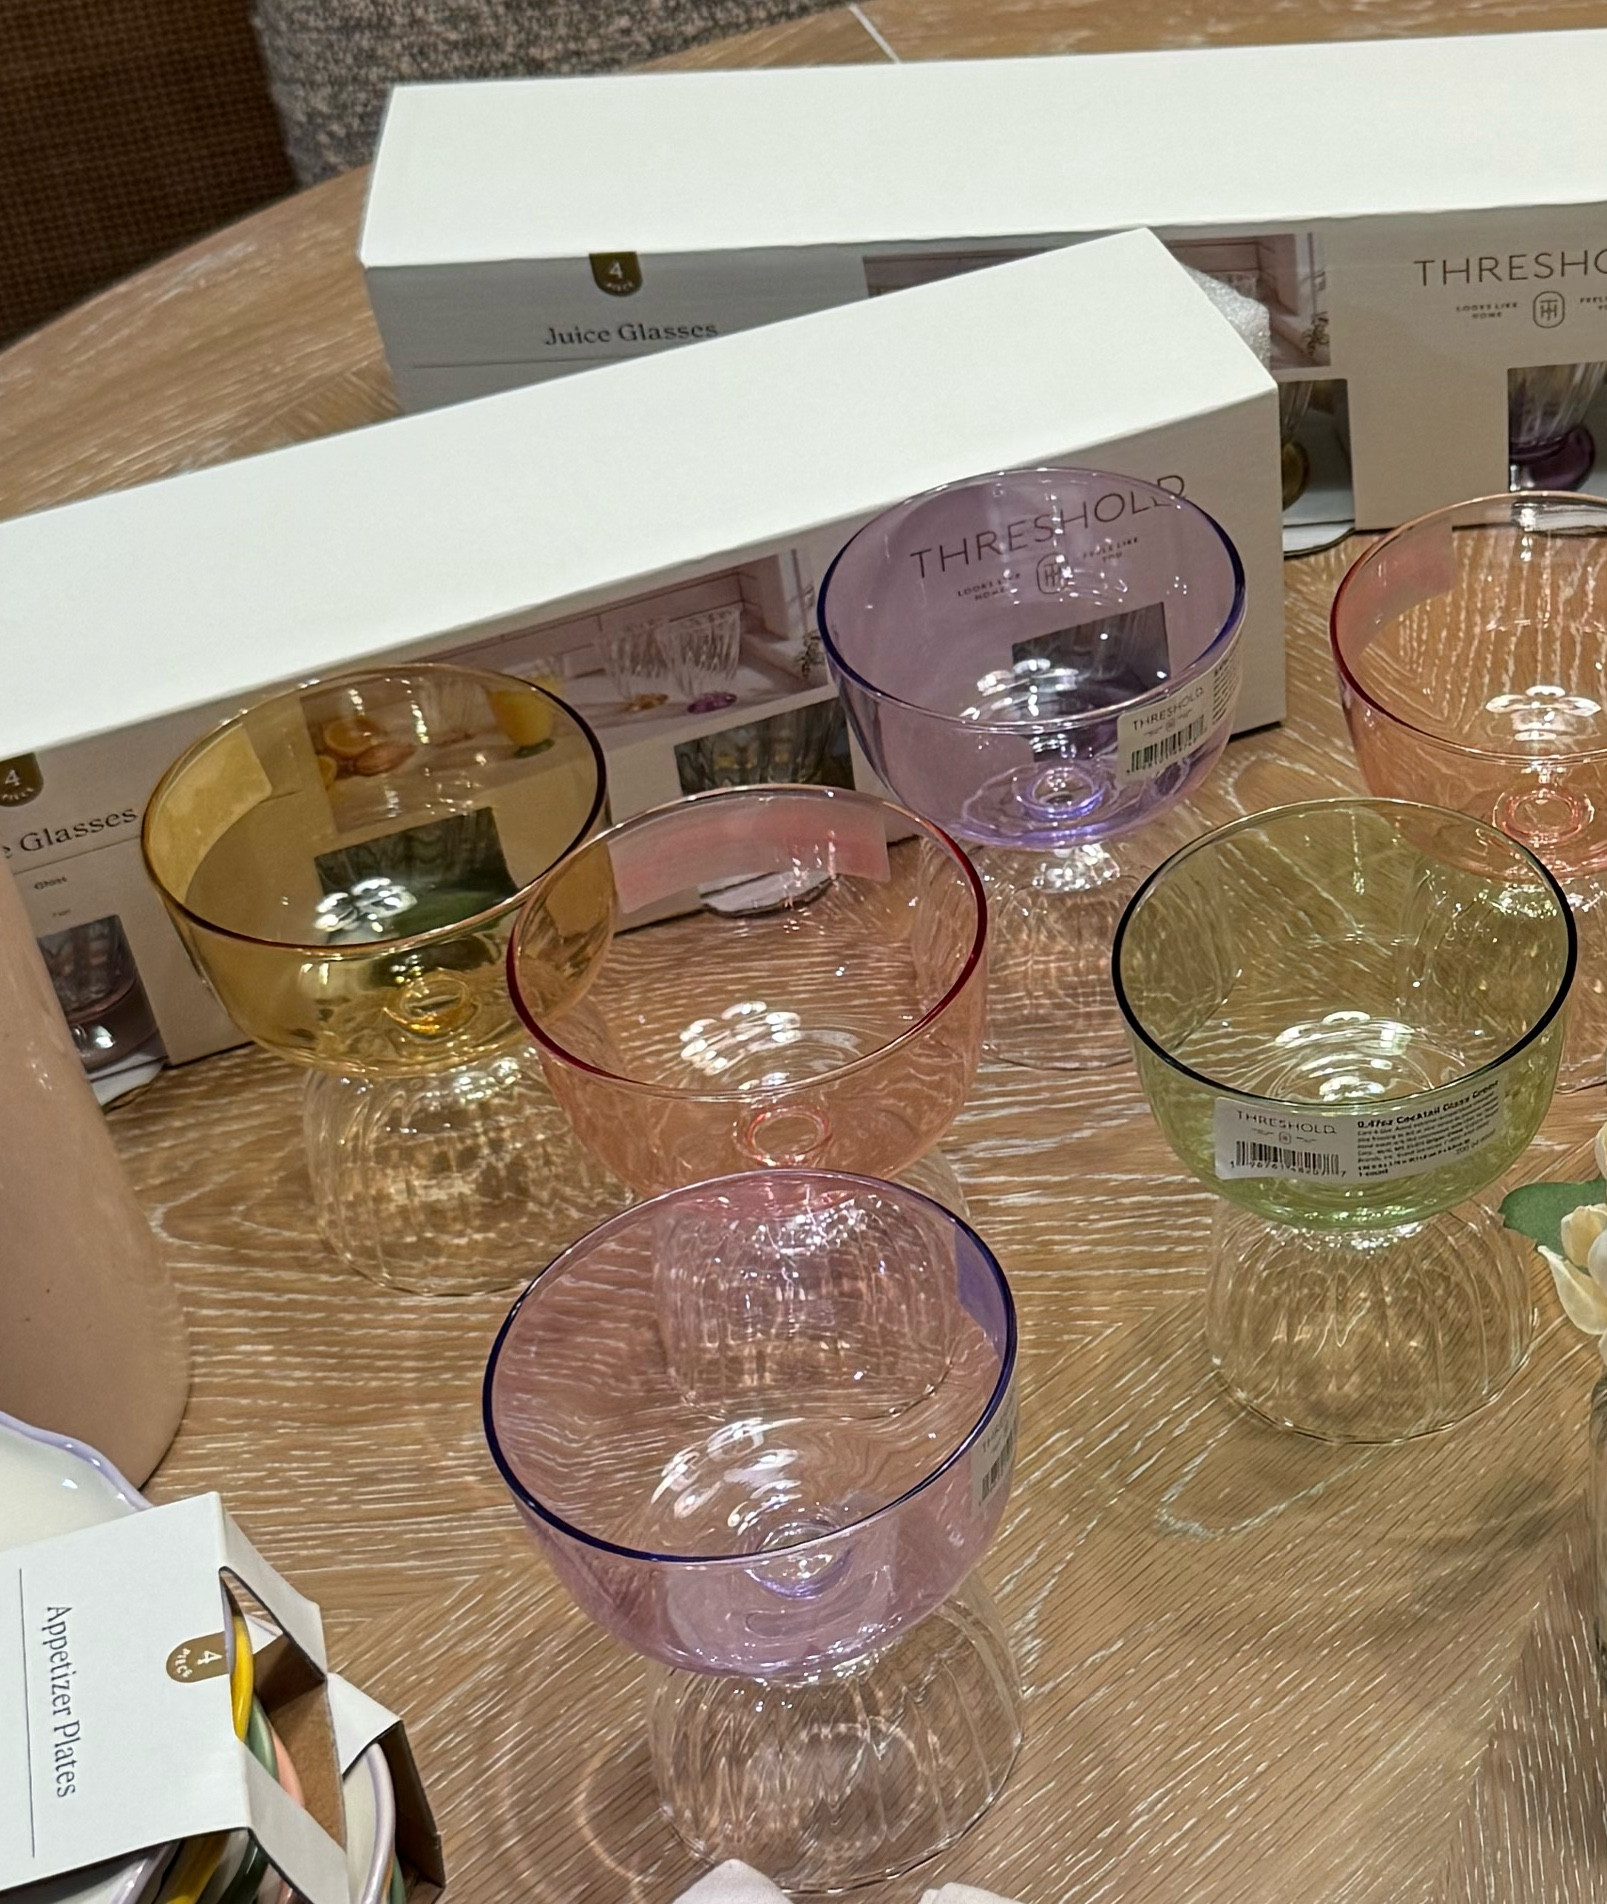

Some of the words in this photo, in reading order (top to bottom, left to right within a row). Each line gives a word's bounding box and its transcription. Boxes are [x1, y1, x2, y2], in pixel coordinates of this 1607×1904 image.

[609, 261, 623, 279] 4
[545, 325, 611, 346] Juice
[618, 322, 719, 342] Glasses
[909, 474, 1186, 579] THRESHOLD
[1133, 686, 1204, 731] THRESHOLD
[4, 769, 20, 786] 4
[20, 807, 139, 852] Glasses
[1237, 1110, 1336, 1135] THRESHOLD
[1396, 1106, 1440, 1124] Cocktail
[1442, 1096, 1470, 1112] Glass
[41, 1604, 77, 1717] Appetizer
[174, 1647, 193, 1678] PIECE
[197, 1649, 223, 1666] 4
[54, 1719, 82, 1798] Plates
